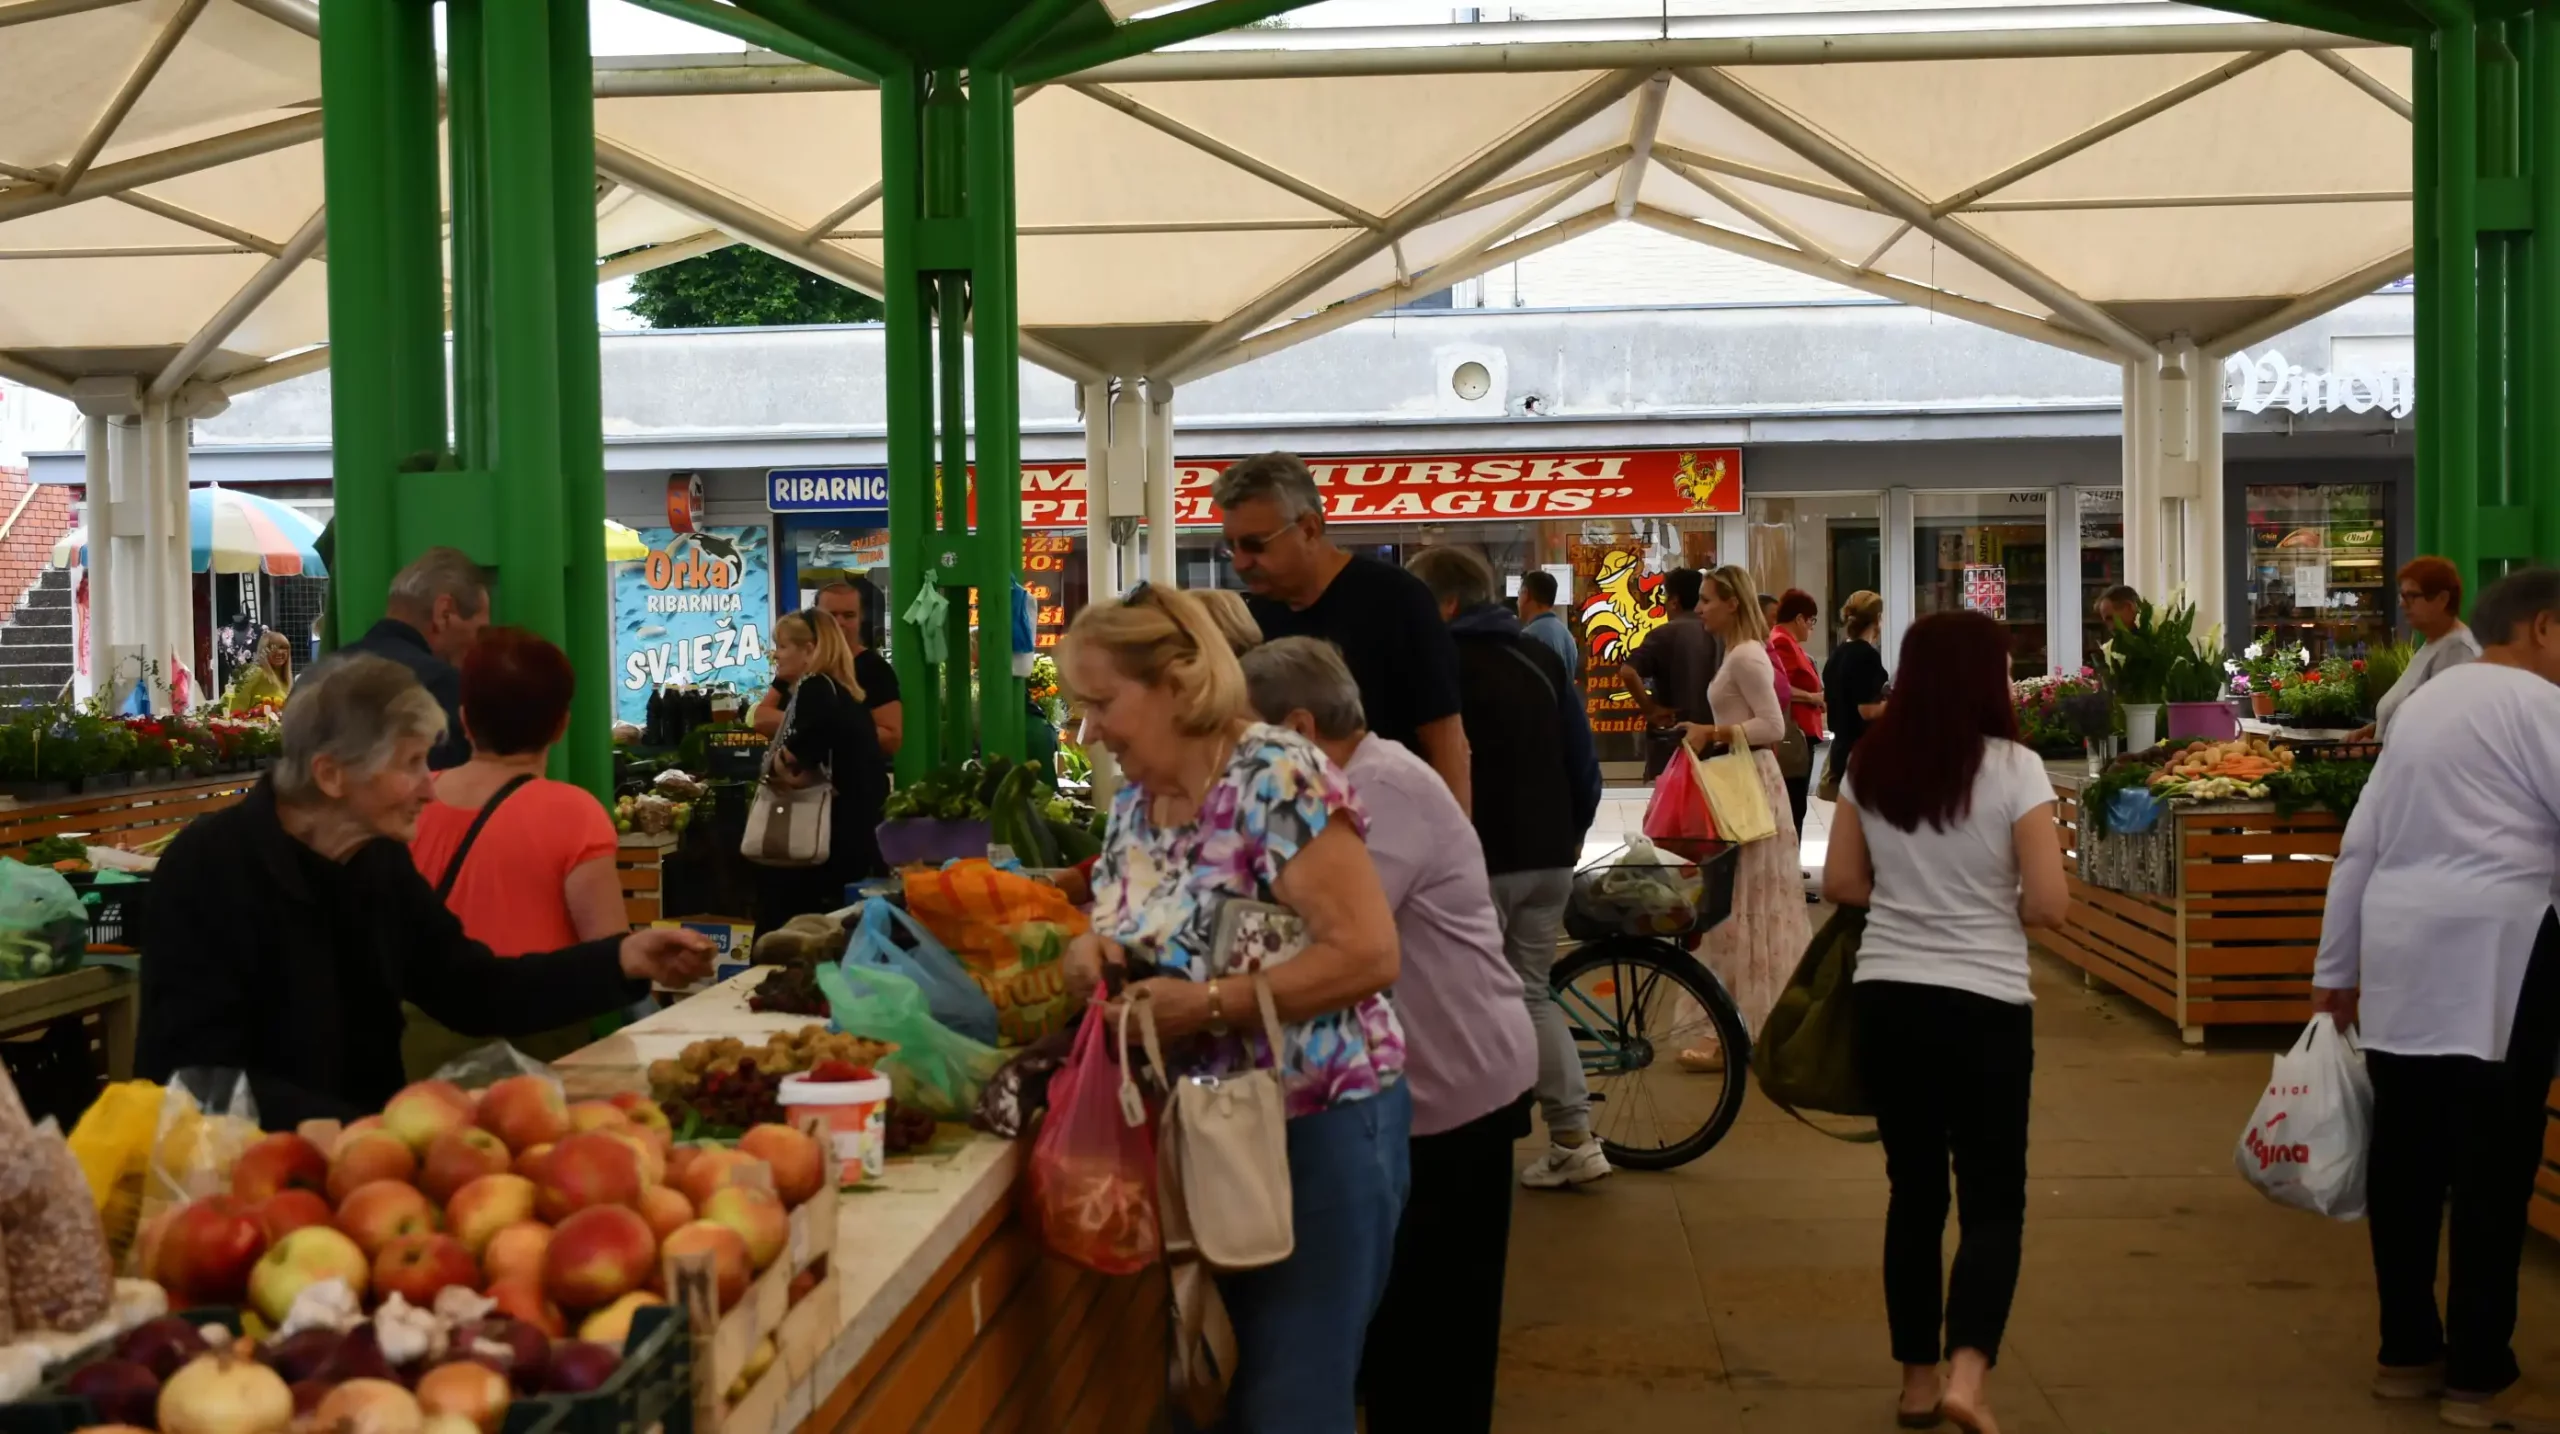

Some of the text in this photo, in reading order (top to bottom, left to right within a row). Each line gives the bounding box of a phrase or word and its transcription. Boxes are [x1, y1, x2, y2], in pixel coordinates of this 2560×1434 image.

[774, 475, 889, 502] RIBARNIC
[645, 548, 730, 590] Orka
[647, 593, 743, 614] RIBARNICA
[624, 617, 764, 691] SVJEŽA
[1588, 715, 1648, 732] kunić
